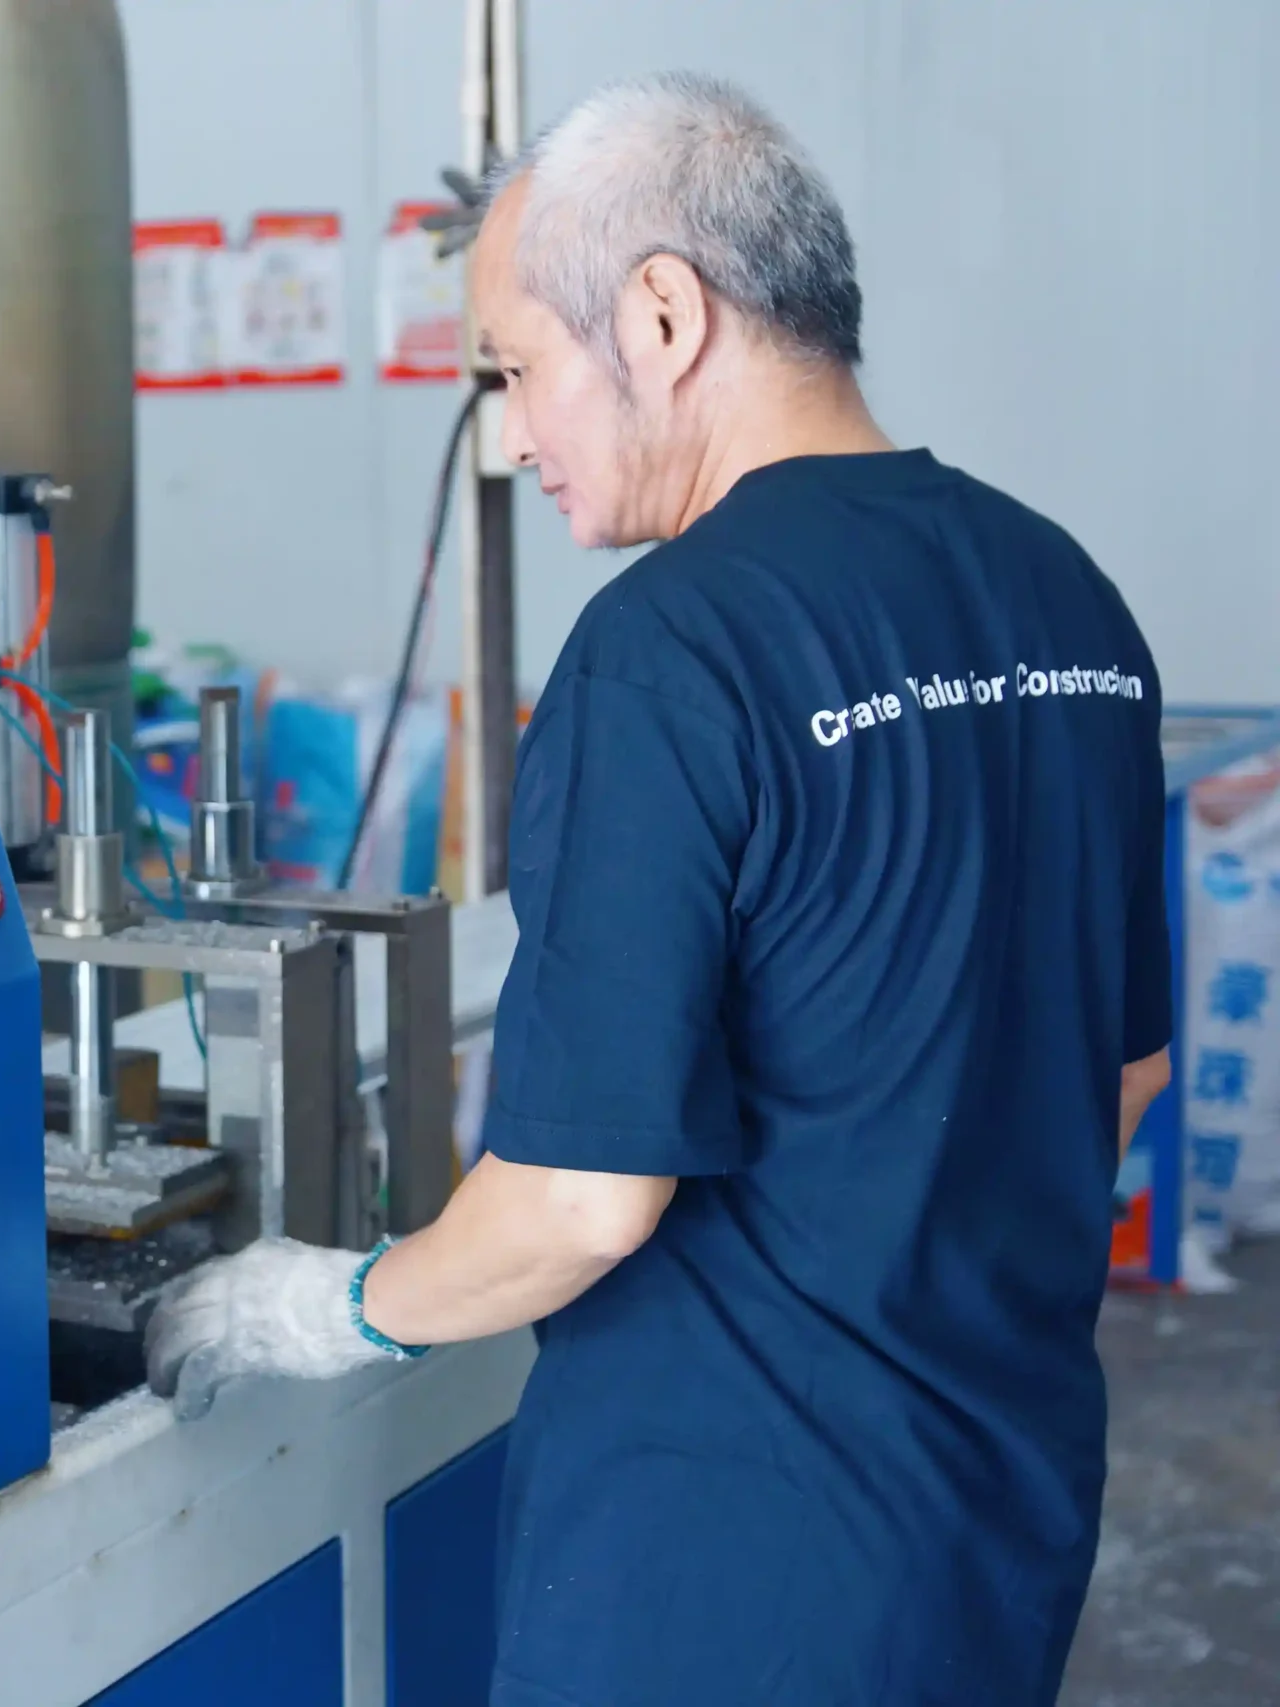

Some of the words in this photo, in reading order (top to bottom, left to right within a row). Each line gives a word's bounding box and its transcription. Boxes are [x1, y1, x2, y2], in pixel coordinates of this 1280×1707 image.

[811, 692, 902, 747] Crate
[905, 674, 969, 710] Valu
[1017, 662, 1143, 700] Construcion
